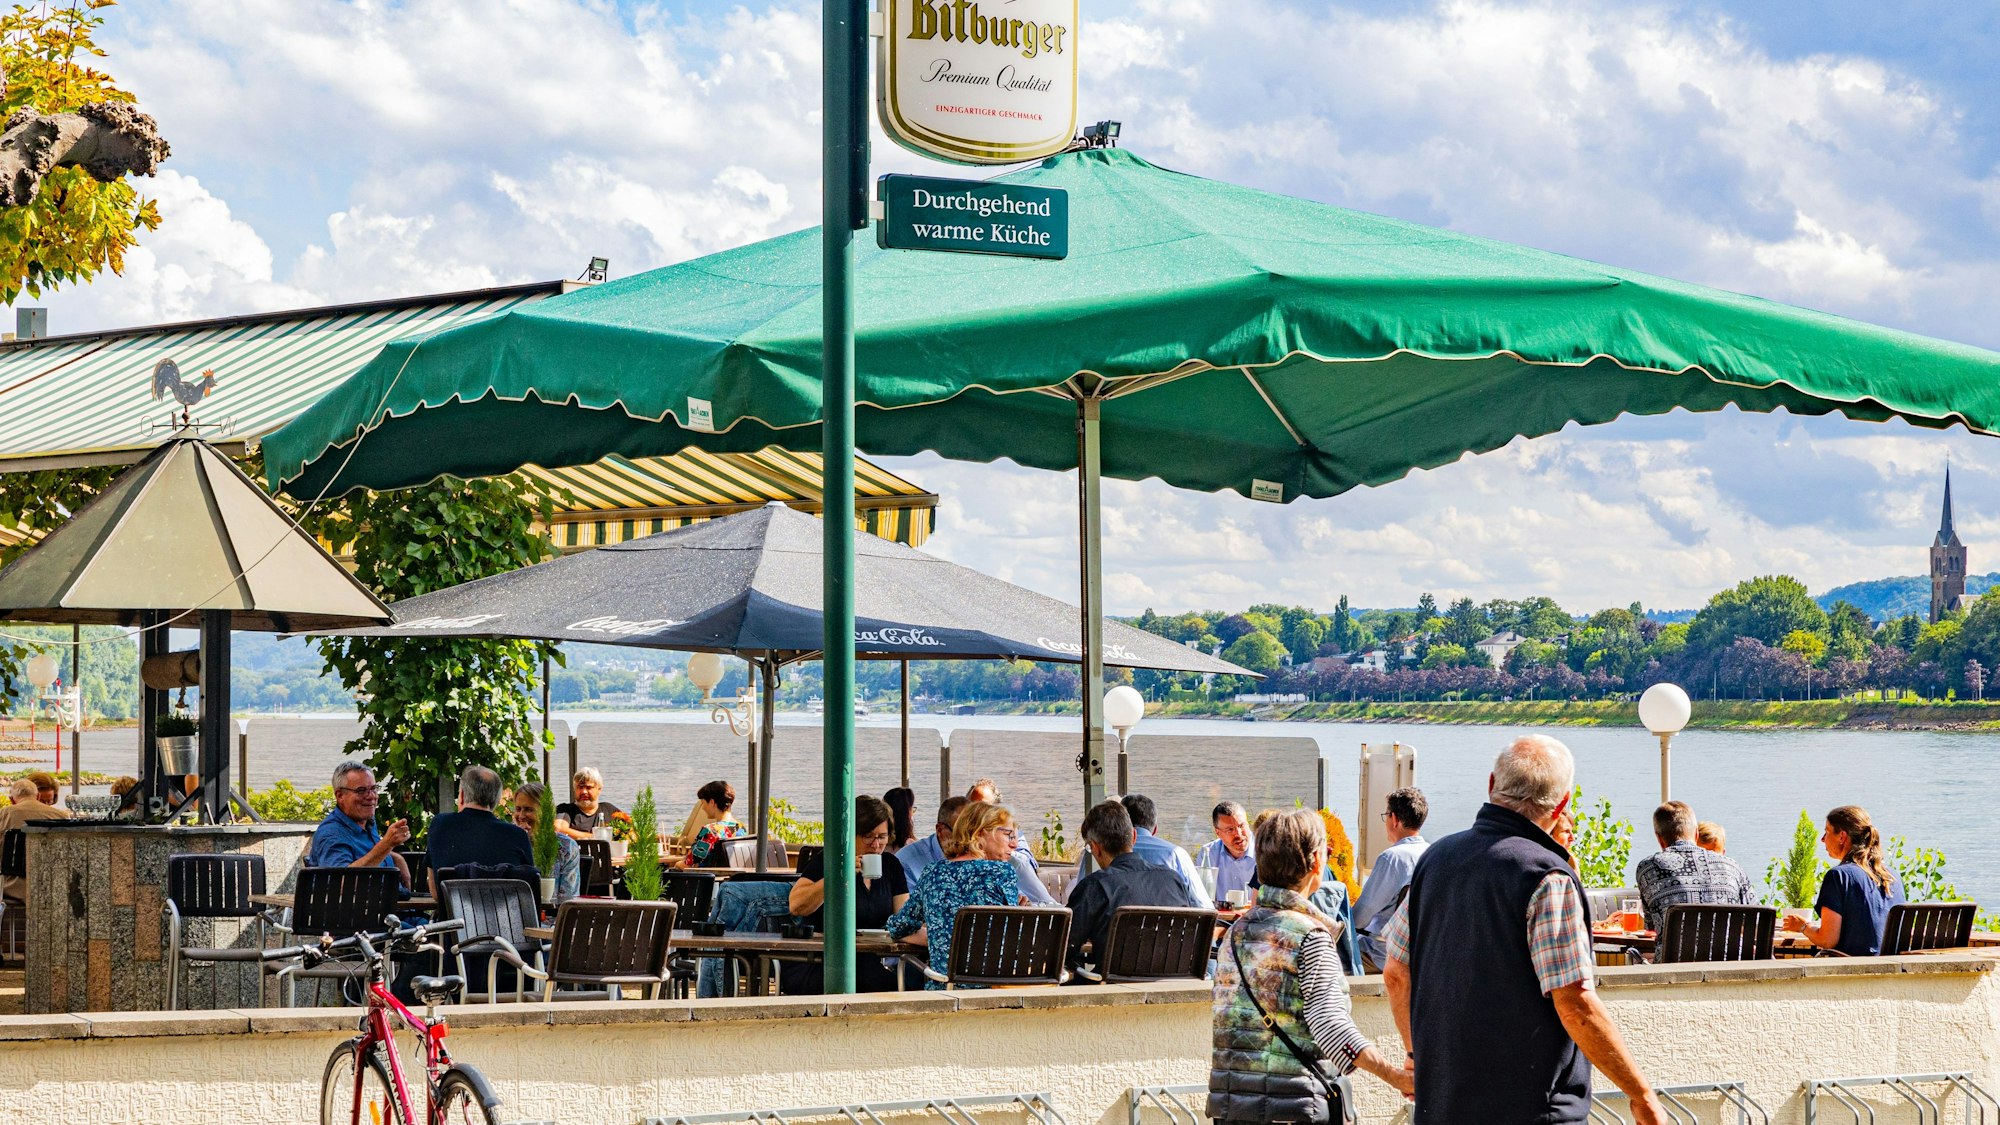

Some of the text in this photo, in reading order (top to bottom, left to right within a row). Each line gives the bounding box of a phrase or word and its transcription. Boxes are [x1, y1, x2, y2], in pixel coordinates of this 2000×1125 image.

[907, 0, 1067, 59] Bitburger
[920, 59, 1053, 93] Premium Qualität
[935, 104, 1043, 121] EINZIGARTIGER GESCHMACK
[912, 189, 1051, 217] Durchgehend
[912, 223, 1051, 246] warme Küche
[855, 627, 946, 646] ca-Cola
